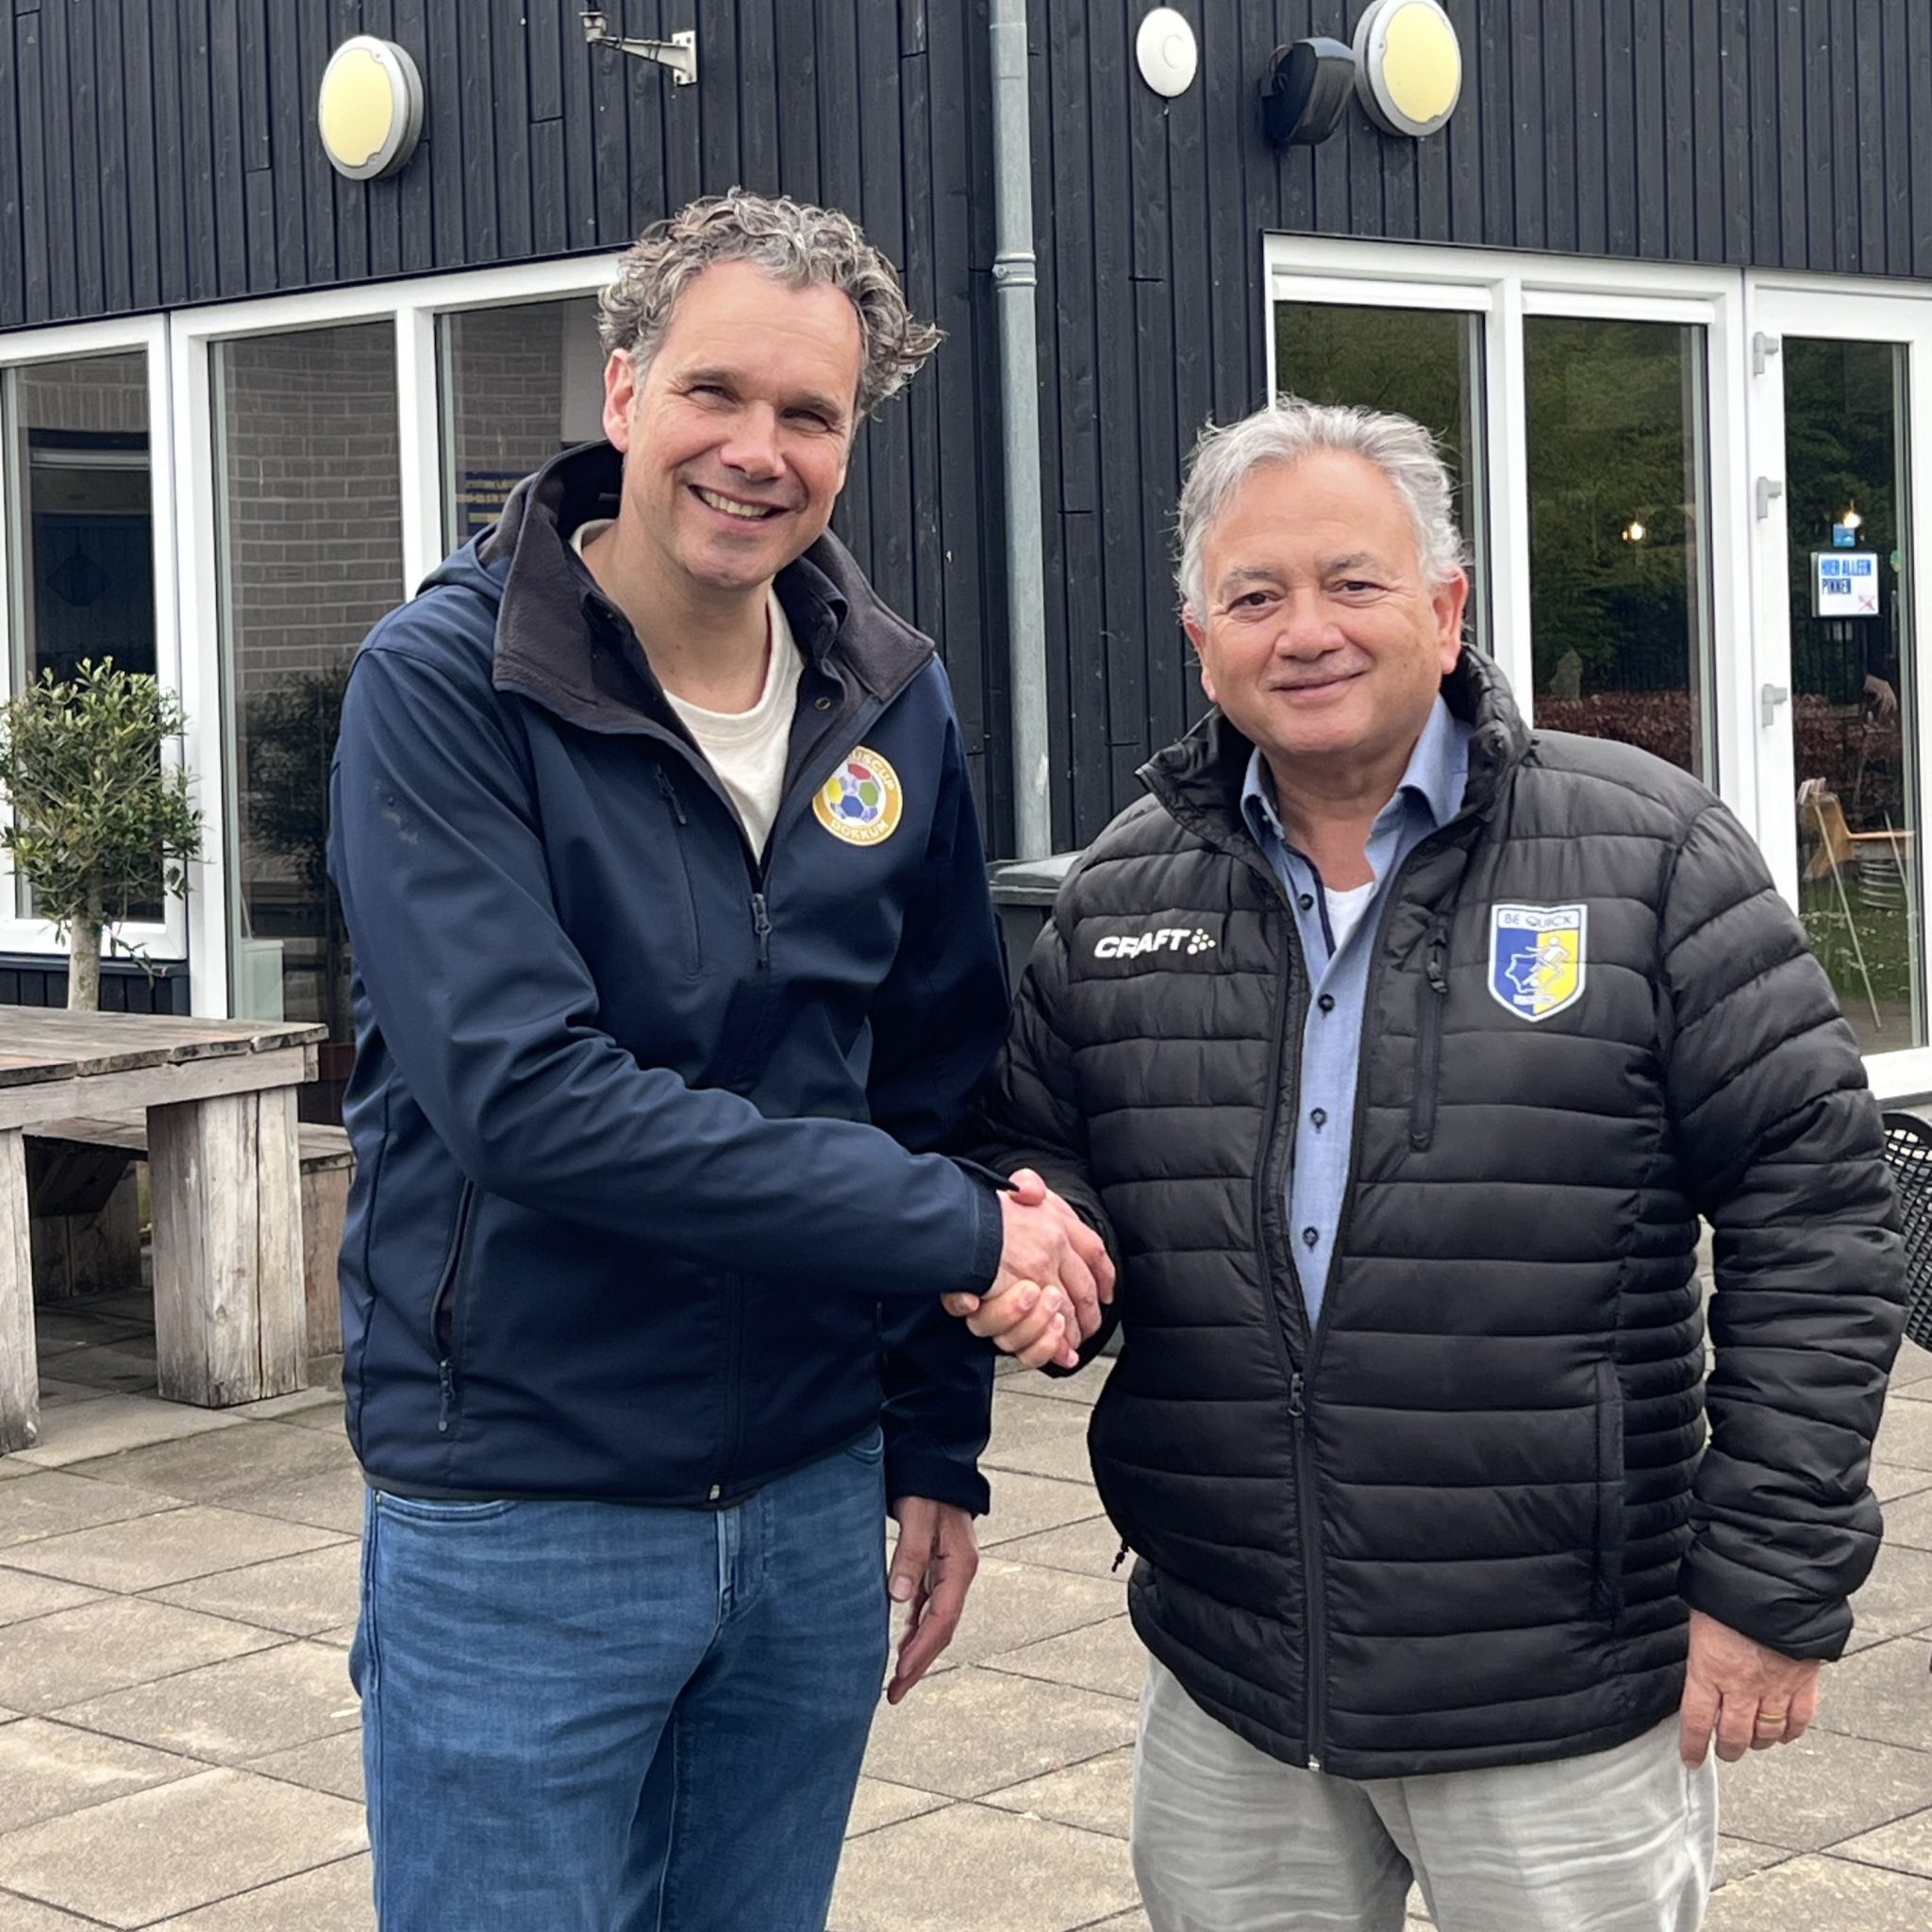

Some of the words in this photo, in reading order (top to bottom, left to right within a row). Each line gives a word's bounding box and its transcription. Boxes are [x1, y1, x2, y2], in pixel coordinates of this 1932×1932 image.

[830, 818, 890, 841] DOKKUM
[1504, 913, 1521, 925] BE
[1524, 914, 1573, 928] QUICK
[1092, 928, 1191, 959] CRAFT
